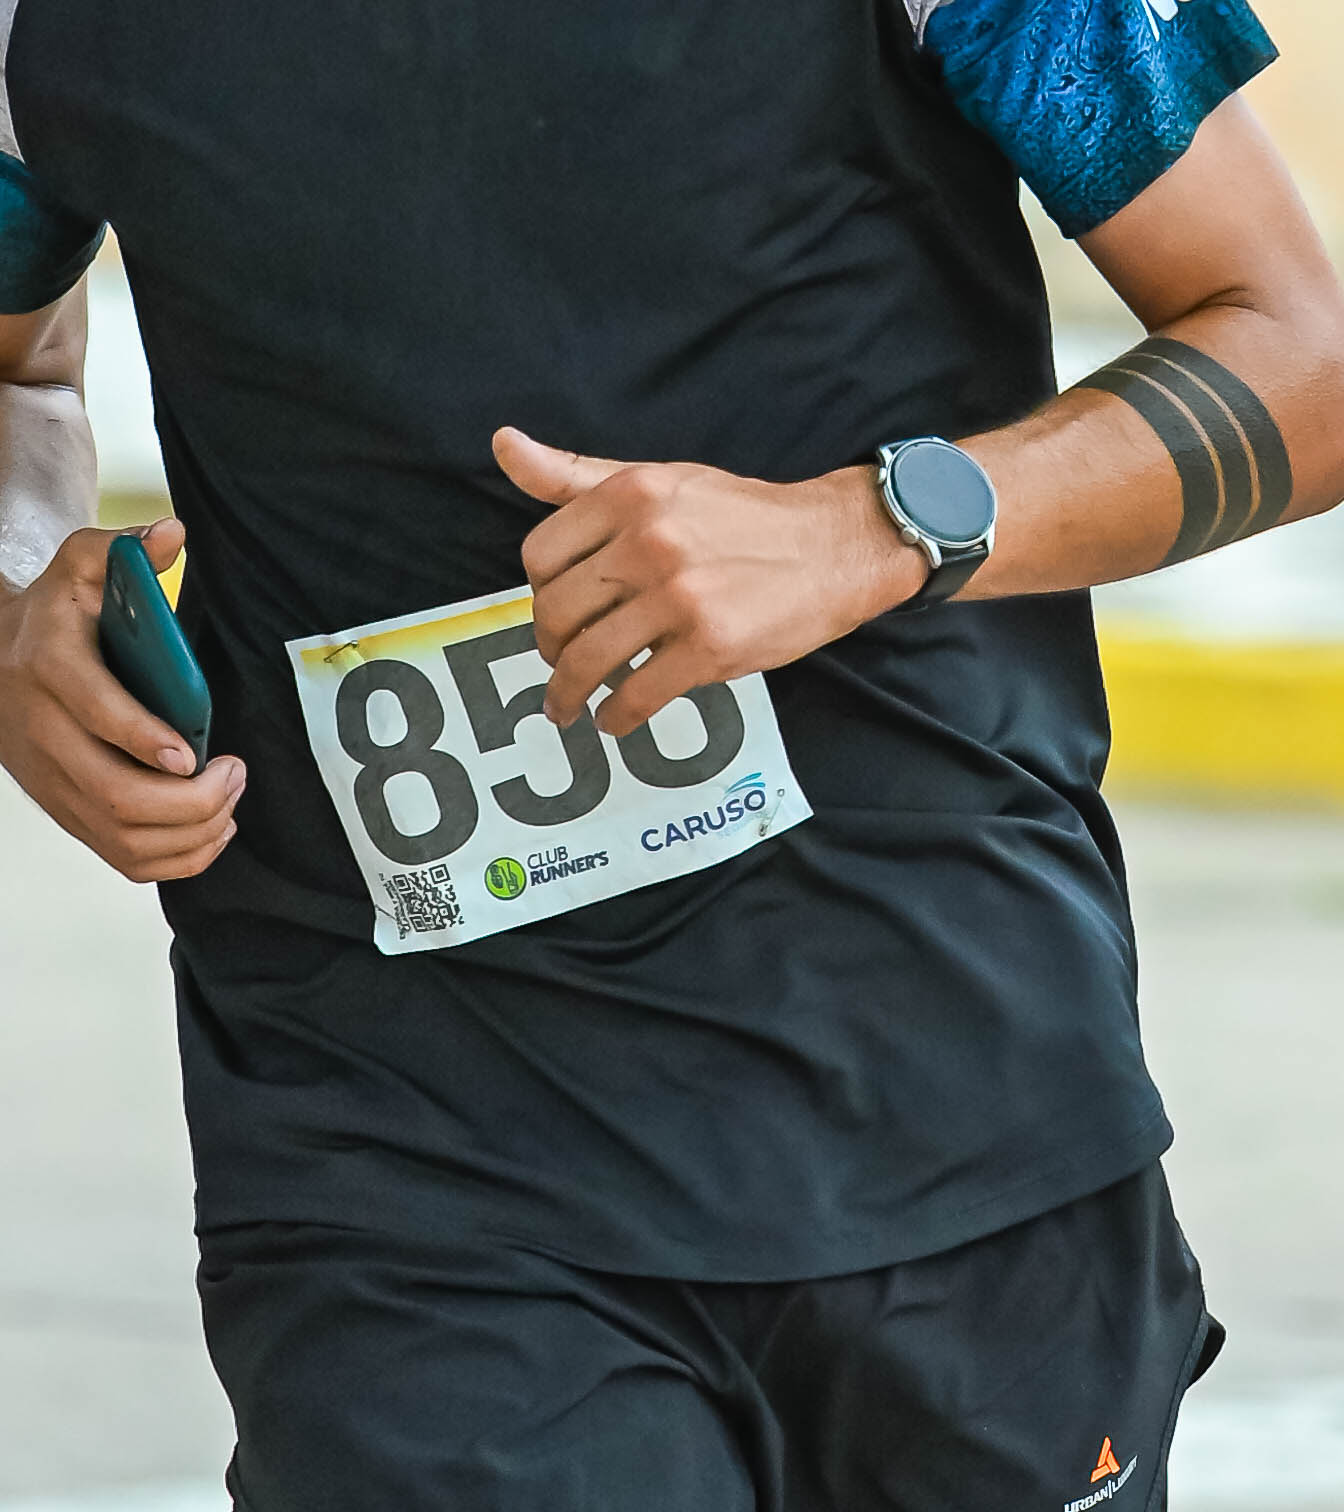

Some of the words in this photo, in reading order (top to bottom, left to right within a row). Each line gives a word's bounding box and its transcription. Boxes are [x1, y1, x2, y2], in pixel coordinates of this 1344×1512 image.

[640, 789, 766, 852] CARUSO
[527, 845, 569, 869] CLUB
[529, 851, 610, 886] RUNNER'S
